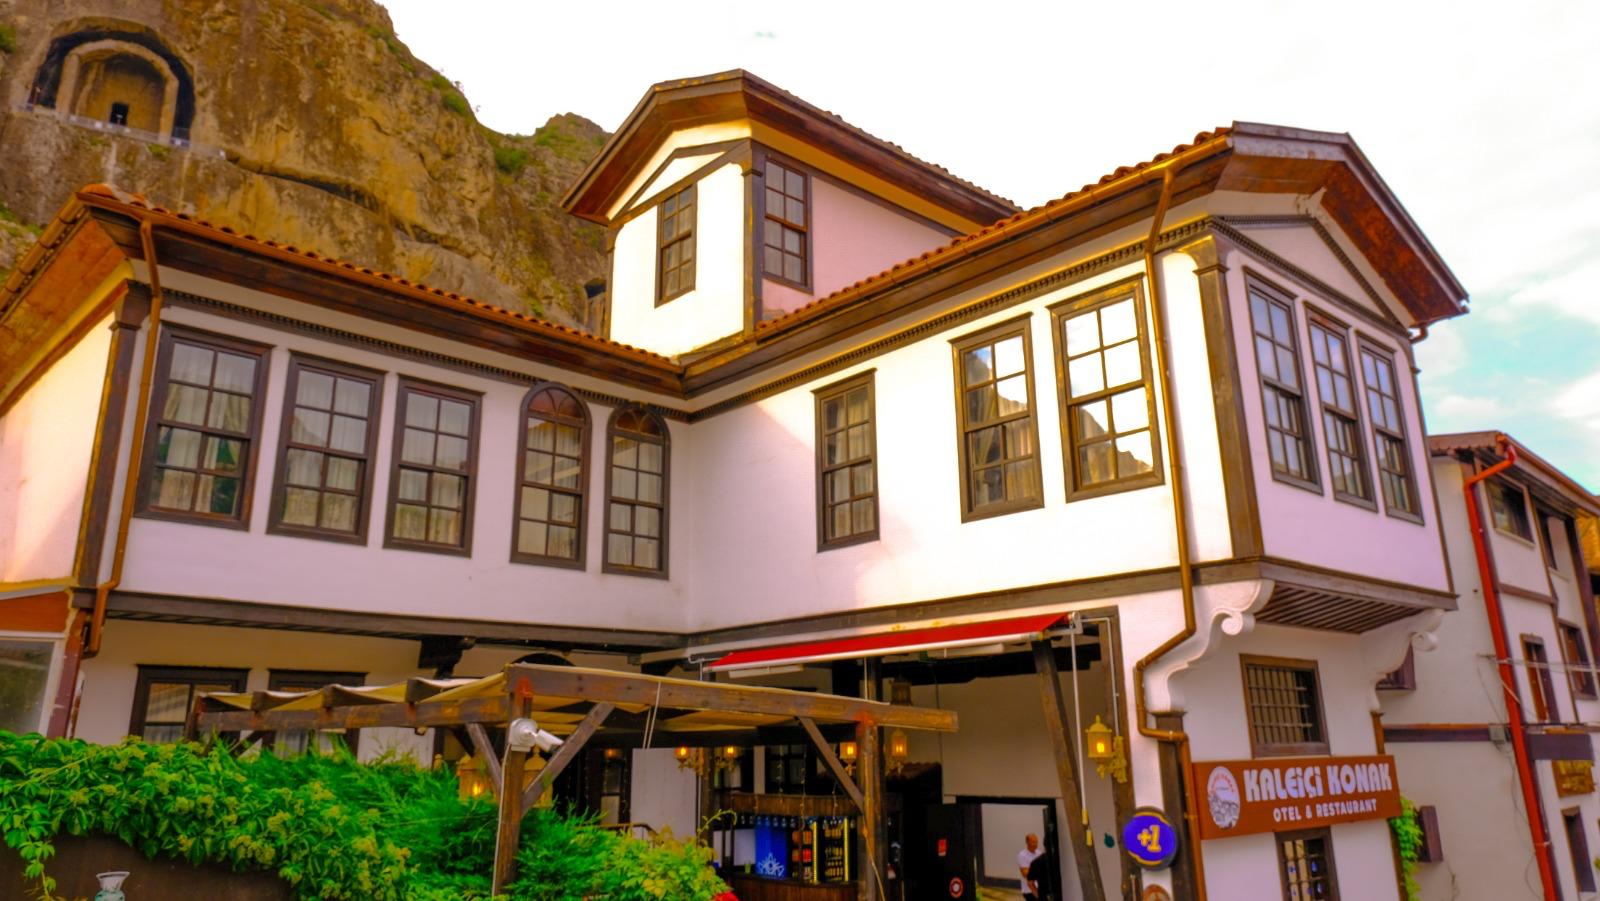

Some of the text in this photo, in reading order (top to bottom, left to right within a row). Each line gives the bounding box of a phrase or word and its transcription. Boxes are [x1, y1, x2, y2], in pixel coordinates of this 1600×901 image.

[1326, 763, 1392, 796] KONAK
[1273, 806, 1302, 822] OTEL
[1316, 798, 1377, 818] RESTAURANT
